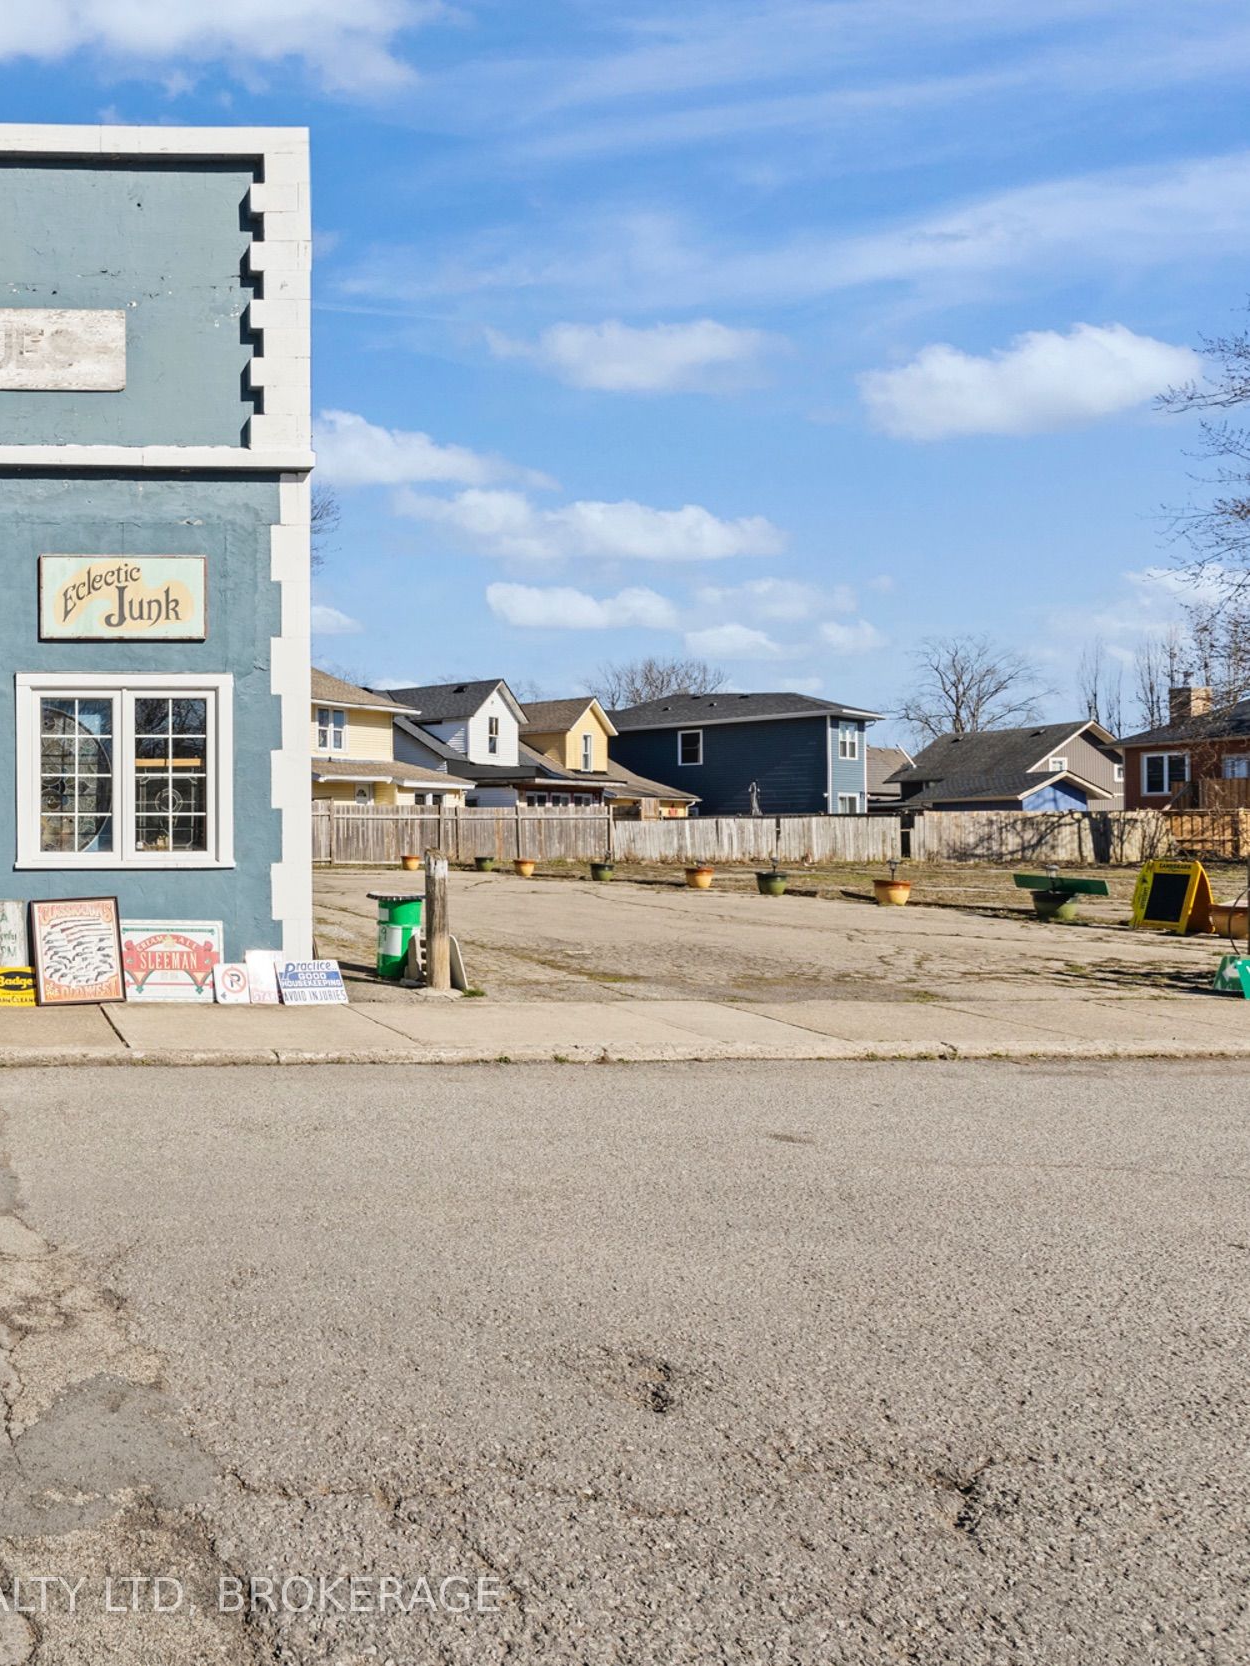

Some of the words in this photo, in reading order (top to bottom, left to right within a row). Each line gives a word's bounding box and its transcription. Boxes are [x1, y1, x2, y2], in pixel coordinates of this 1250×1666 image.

[62, 563, 141, 623] Eclectic
[104, 584, 182, 628] Junk
[140, 951, 197, 970] SLEEMAN
[298, 972, 327, 980] GOOD
[11, 996, 35, 1004] CLEAN
[284, 990, 308, 1002] AVOID
